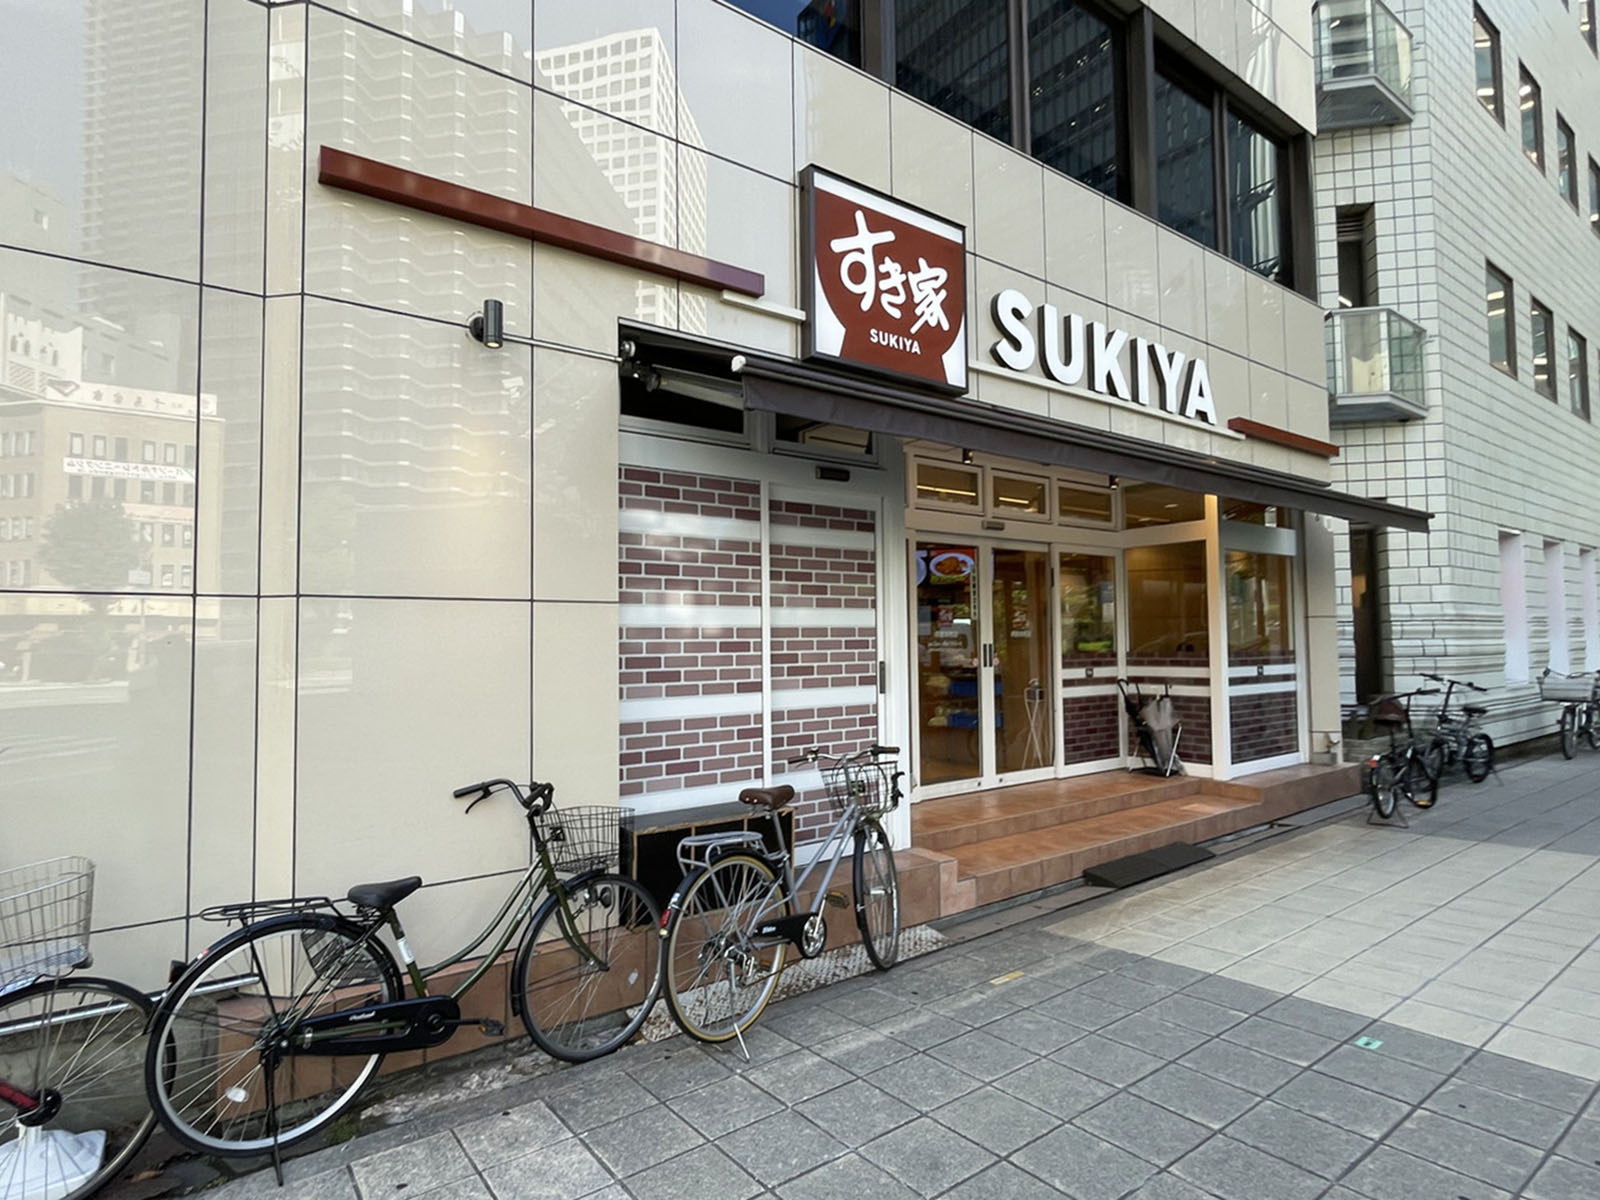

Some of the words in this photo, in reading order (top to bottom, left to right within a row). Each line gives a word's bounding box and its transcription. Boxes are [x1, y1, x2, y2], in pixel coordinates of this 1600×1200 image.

[830, 209, 950, 334] すき家
[869, 328, 921, 355] SUKIYA
[990, 289, 1217, 425] SUKIYA
